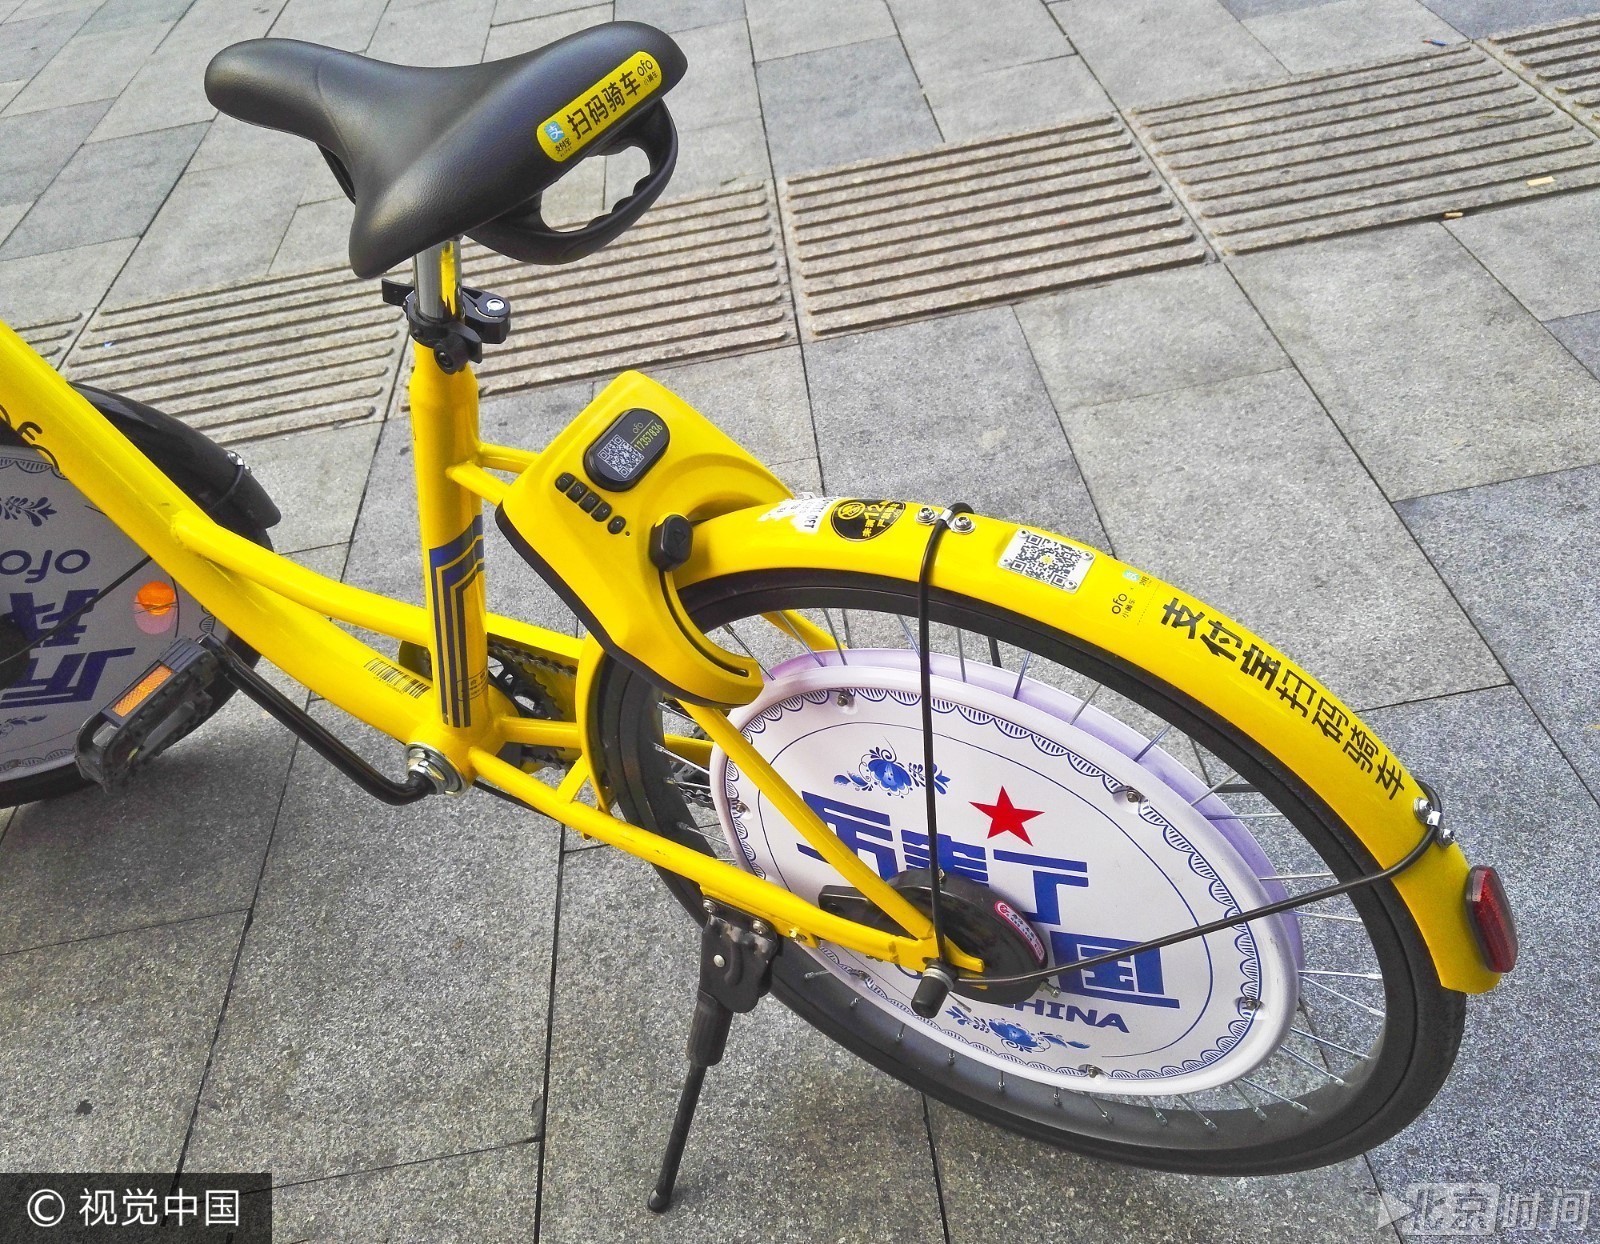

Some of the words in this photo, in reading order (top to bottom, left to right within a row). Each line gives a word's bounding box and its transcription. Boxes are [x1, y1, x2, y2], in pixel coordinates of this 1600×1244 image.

[636, 59, 654, 77] ofo
[566, 70, 641, 140] 扫码骑车
[632, 422, 644, 434] ofo
[633, 422, 663, 451] 17357836
[0, 549, 91, 584] ofo
[1111, 593, 1128, 615] ofo
[1160, 597, 1405, 801] 支付宝扫码骑车
[1004, 998, 1130, 1034] HINA
